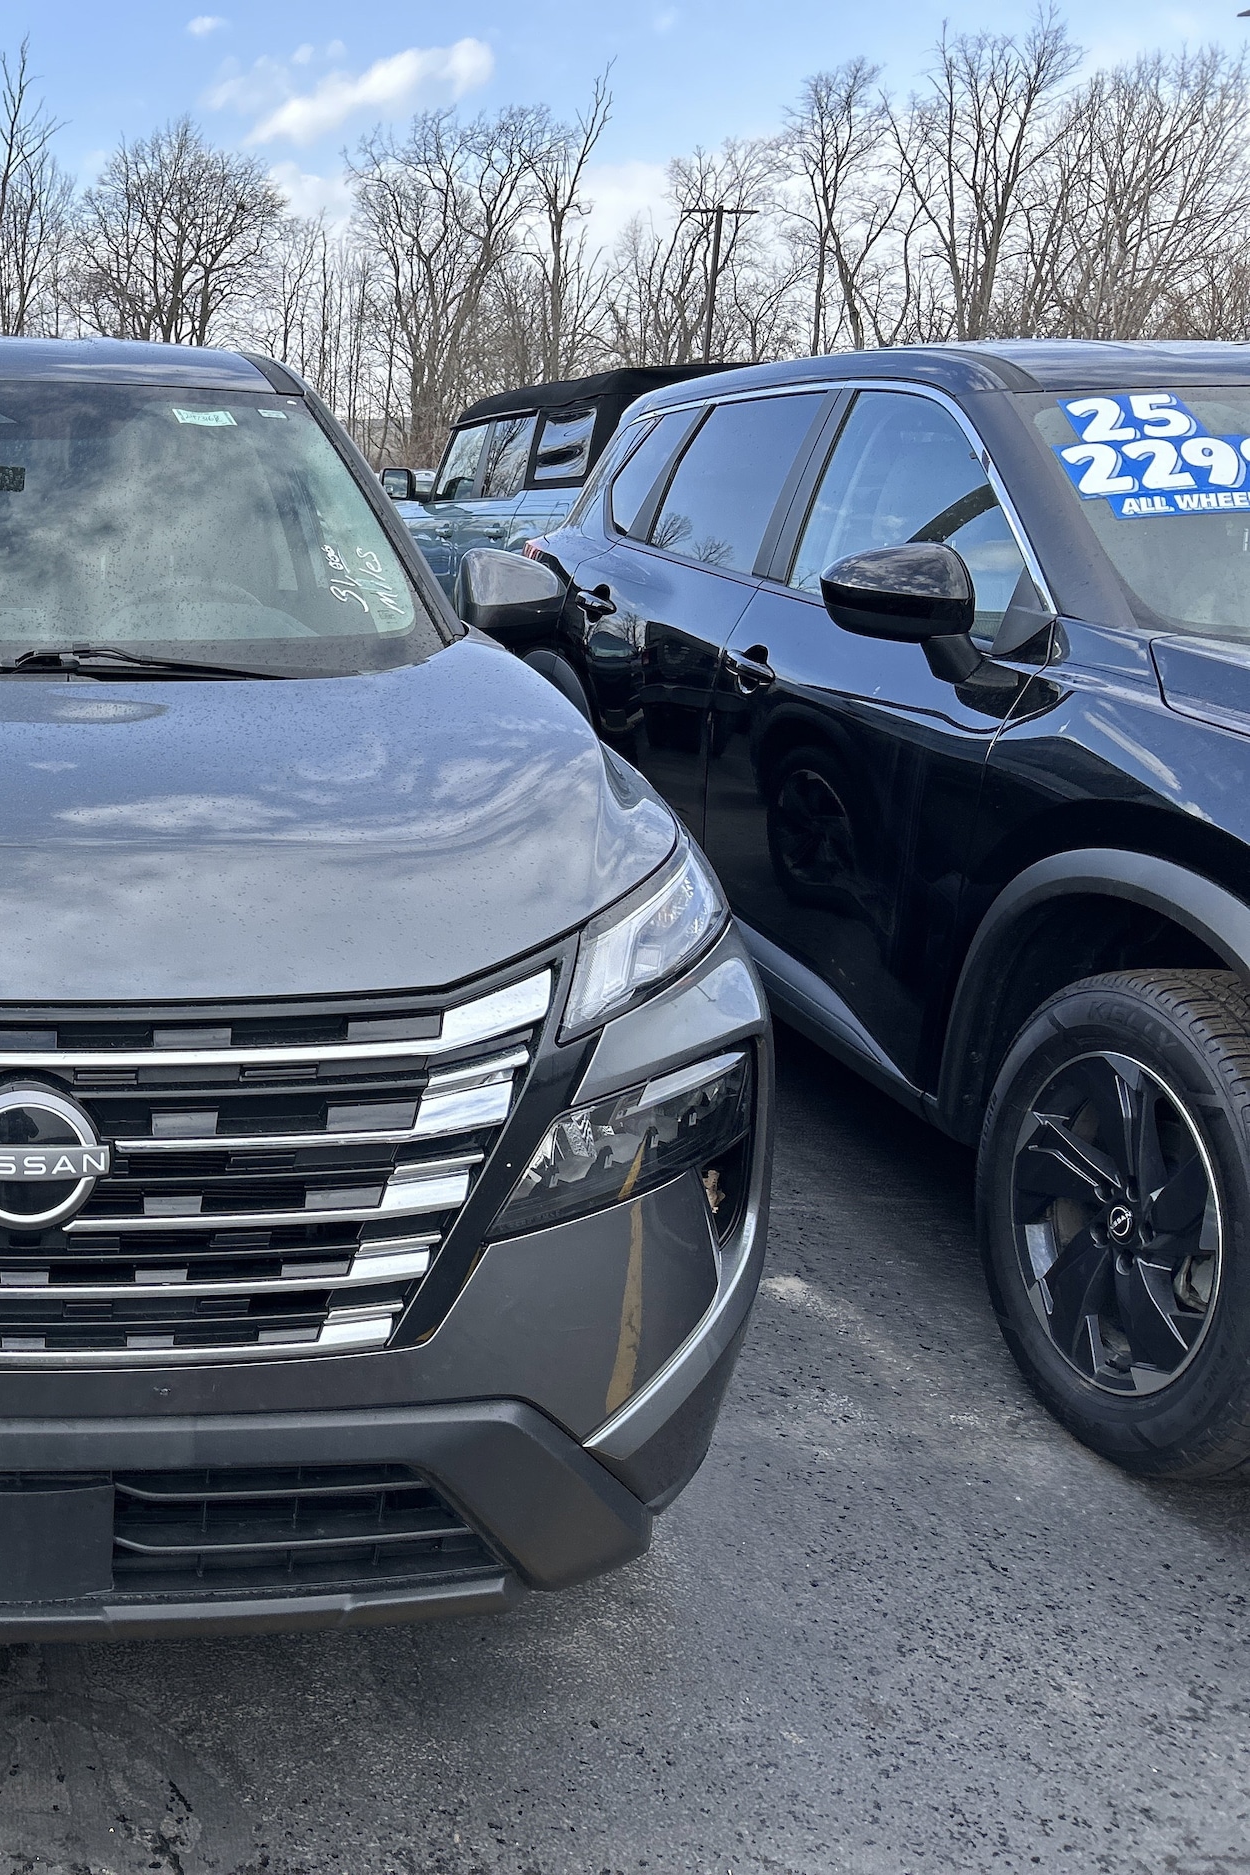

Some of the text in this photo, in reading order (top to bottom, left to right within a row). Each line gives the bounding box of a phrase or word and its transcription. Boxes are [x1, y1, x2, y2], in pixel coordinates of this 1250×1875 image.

[1066, 394, 1197, 443] 25
[1061, 436, 1250, 495] 229
[1121, 491, 1250, 515] ALL WHEE
